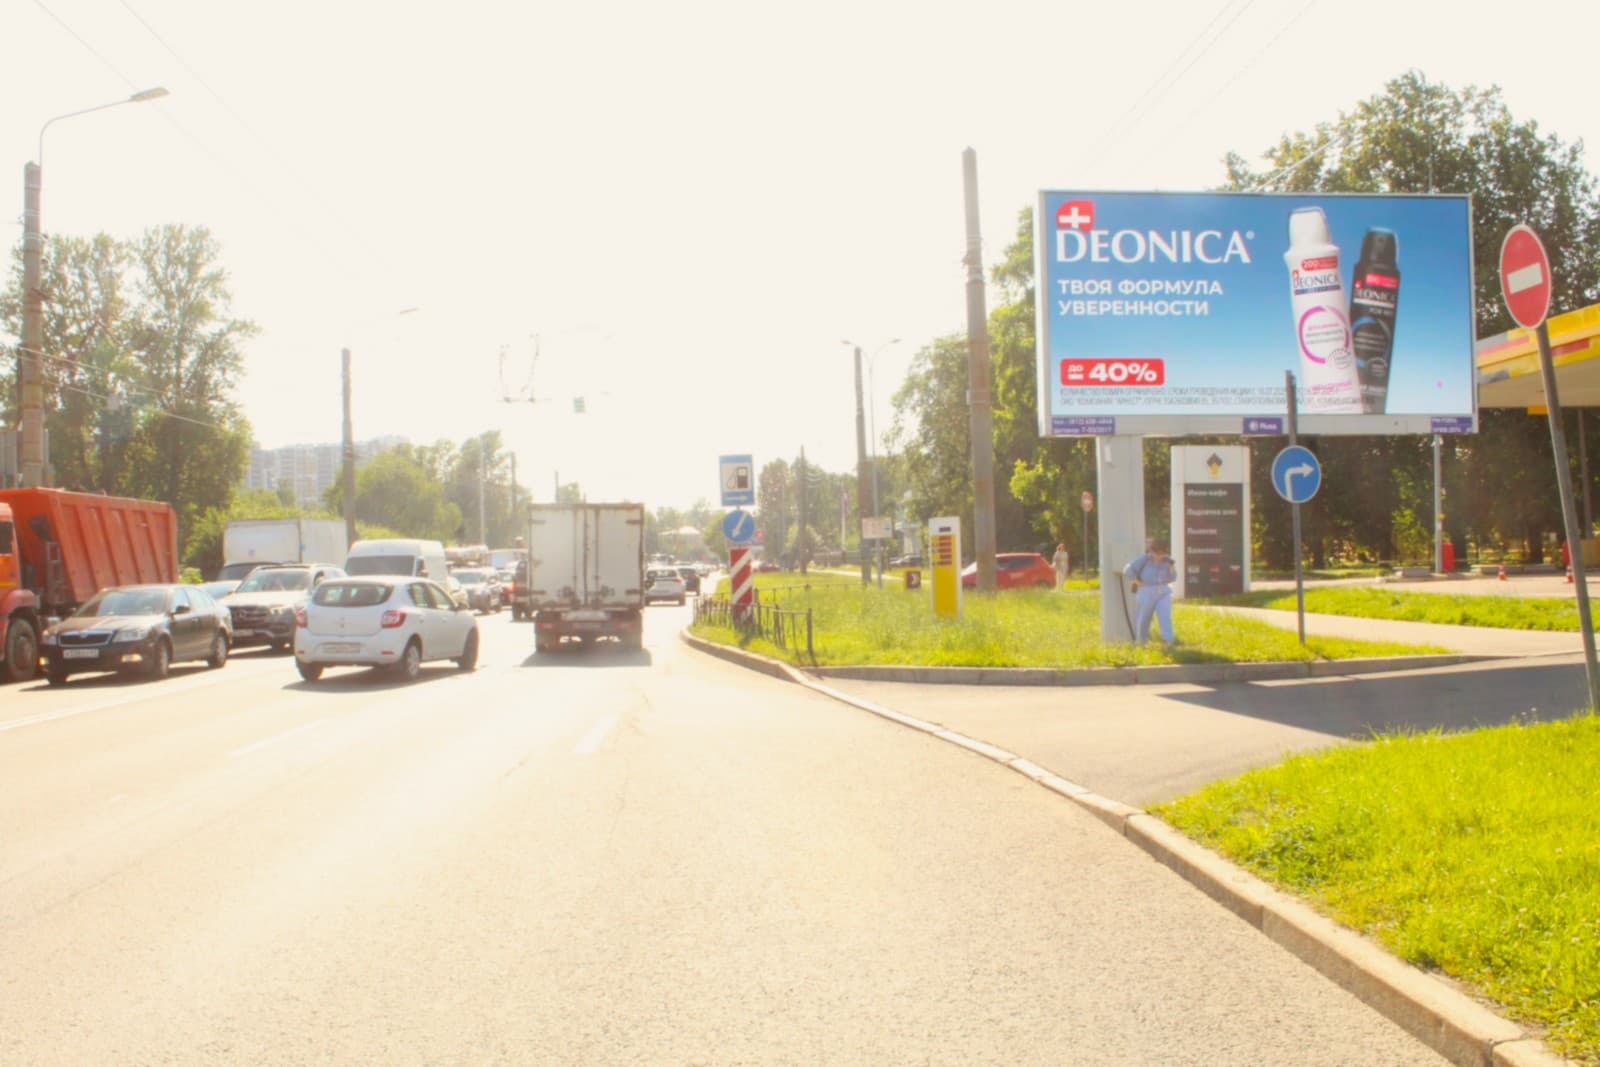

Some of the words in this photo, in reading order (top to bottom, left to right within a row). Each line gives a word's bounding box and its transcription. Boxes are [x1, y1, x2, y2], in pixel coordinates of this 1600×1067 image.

[1056, 229, 1251, 264] DEONICA
[1057, 279, 1112, 295] ТВОЯ
[1118, 279, 1223, 295] ФОРМУЛА
[1058, 300, 1209, 316] УВЕРЕННОСТИ
